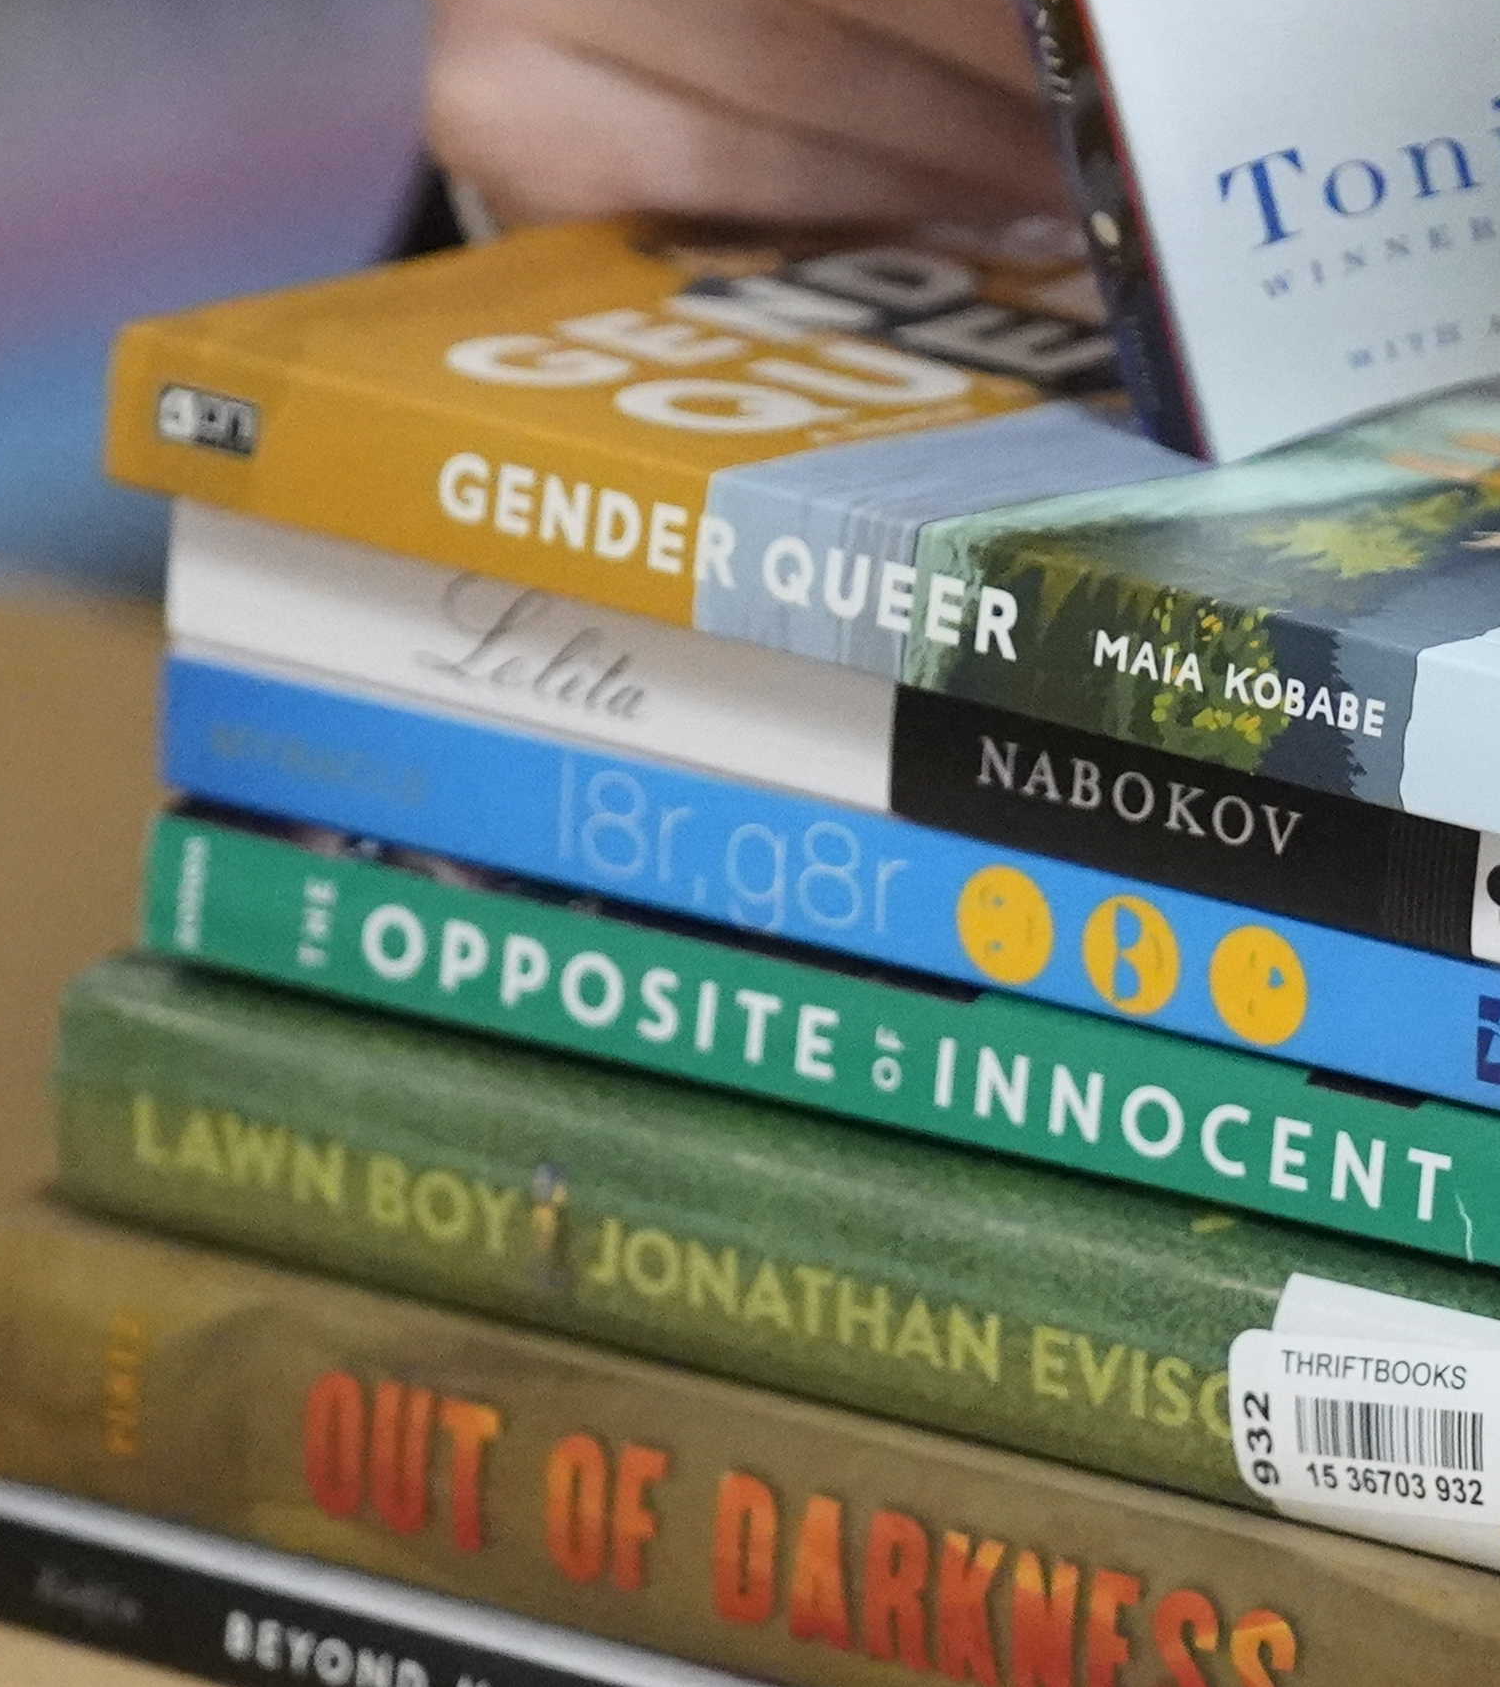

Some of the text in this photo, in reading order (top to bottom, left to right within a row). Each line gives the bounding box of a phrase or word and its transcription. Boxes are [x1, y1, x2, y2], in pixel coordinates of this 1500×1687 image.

[1263, 214, 1498, 298] WINNER
[438, 451, 1386, 738] GENDER QUEER MAIA KOBABE
[412, 570, 1304, 858] Lolita NABOKOV
[298, 877, 339, 968] THE
[361, 903, 842, 1082] OPPOSITE
[871, 1021, 904, 1093] OF
[932, 1037, 1453, 1222] INNOCENT
[131, 1093, 1232, 1439] LAWN BOY JONATHAN EVISO
[1243, 1390, 1279, 1486] 932
[1281, 1349, 1468, 1390] THRIFTBOOKS
[304, 1369, 500, 1554] OUT
[546, 1430, 672, 1592] OF
[712, 1469, 1297, 1687] DARKNESS
[1306, 1462, 1485, 1506] 15 36703 932
[224, 1610, 430, 1687] BEYOND
